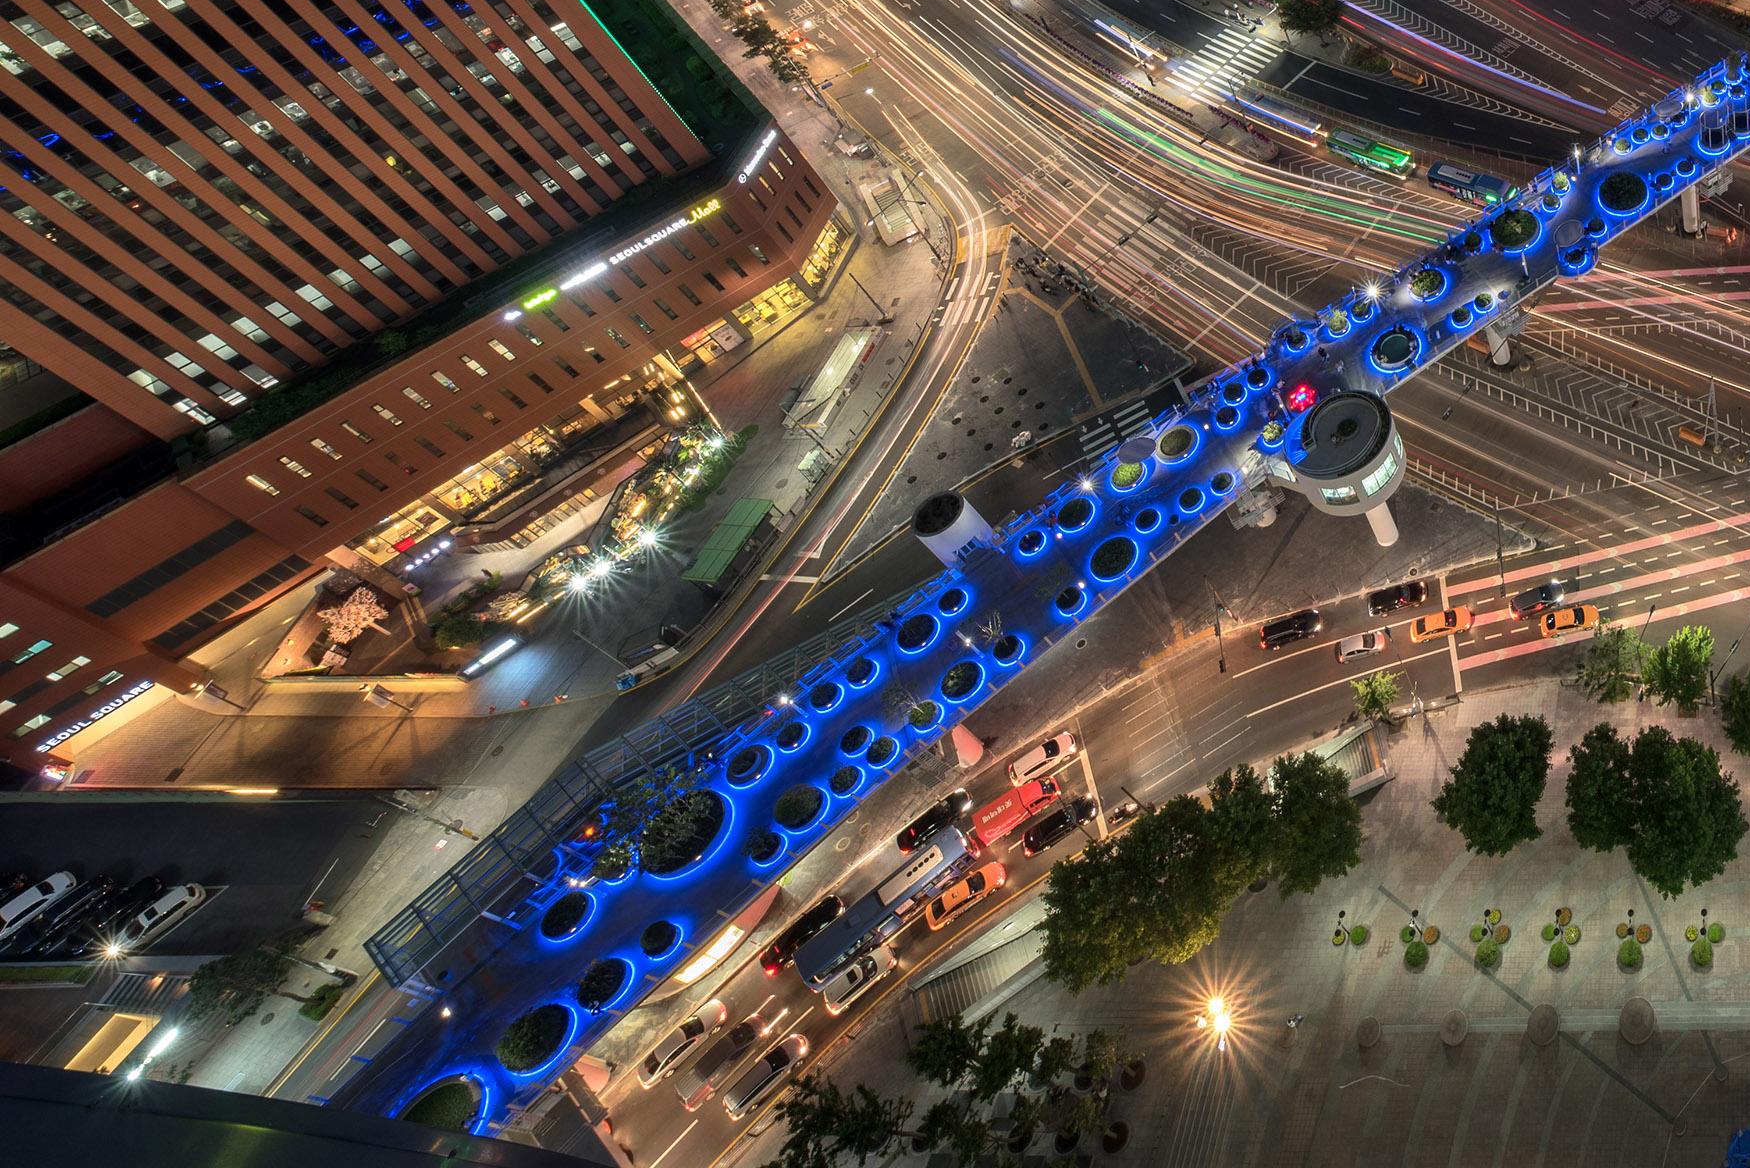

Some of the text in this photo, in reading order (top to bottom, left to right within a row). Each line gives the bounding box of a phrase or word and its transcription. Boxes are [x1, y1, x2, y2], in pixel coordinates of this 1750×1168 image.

[687, 198, 721, 225] Mall
[36, 679, 154, 753] SEOUL SQUARE
